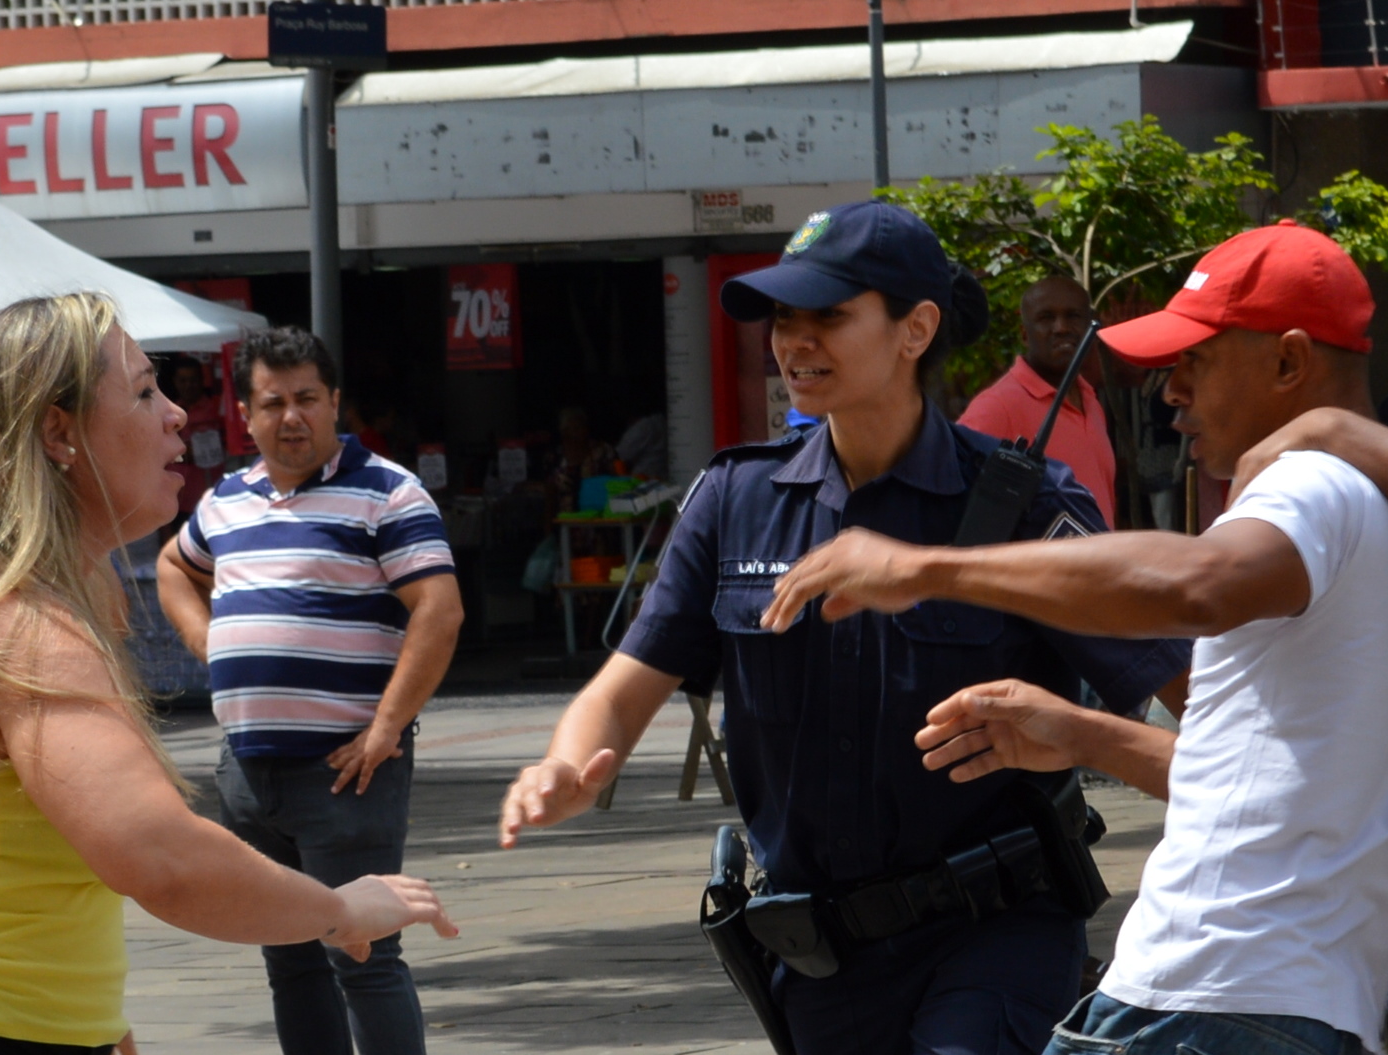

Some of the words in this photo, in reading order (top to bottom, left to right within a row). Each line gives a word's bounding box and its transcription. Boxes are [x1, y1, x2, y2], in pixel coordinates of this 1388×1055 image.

[274, 18, 304, 31] Praça
[306, 18, 325, 32] Ruy
[327, 19, 369, 32] Barbosa
[702, 192, 740, 208] MDS
[490, 320, 511, 338] OFF
